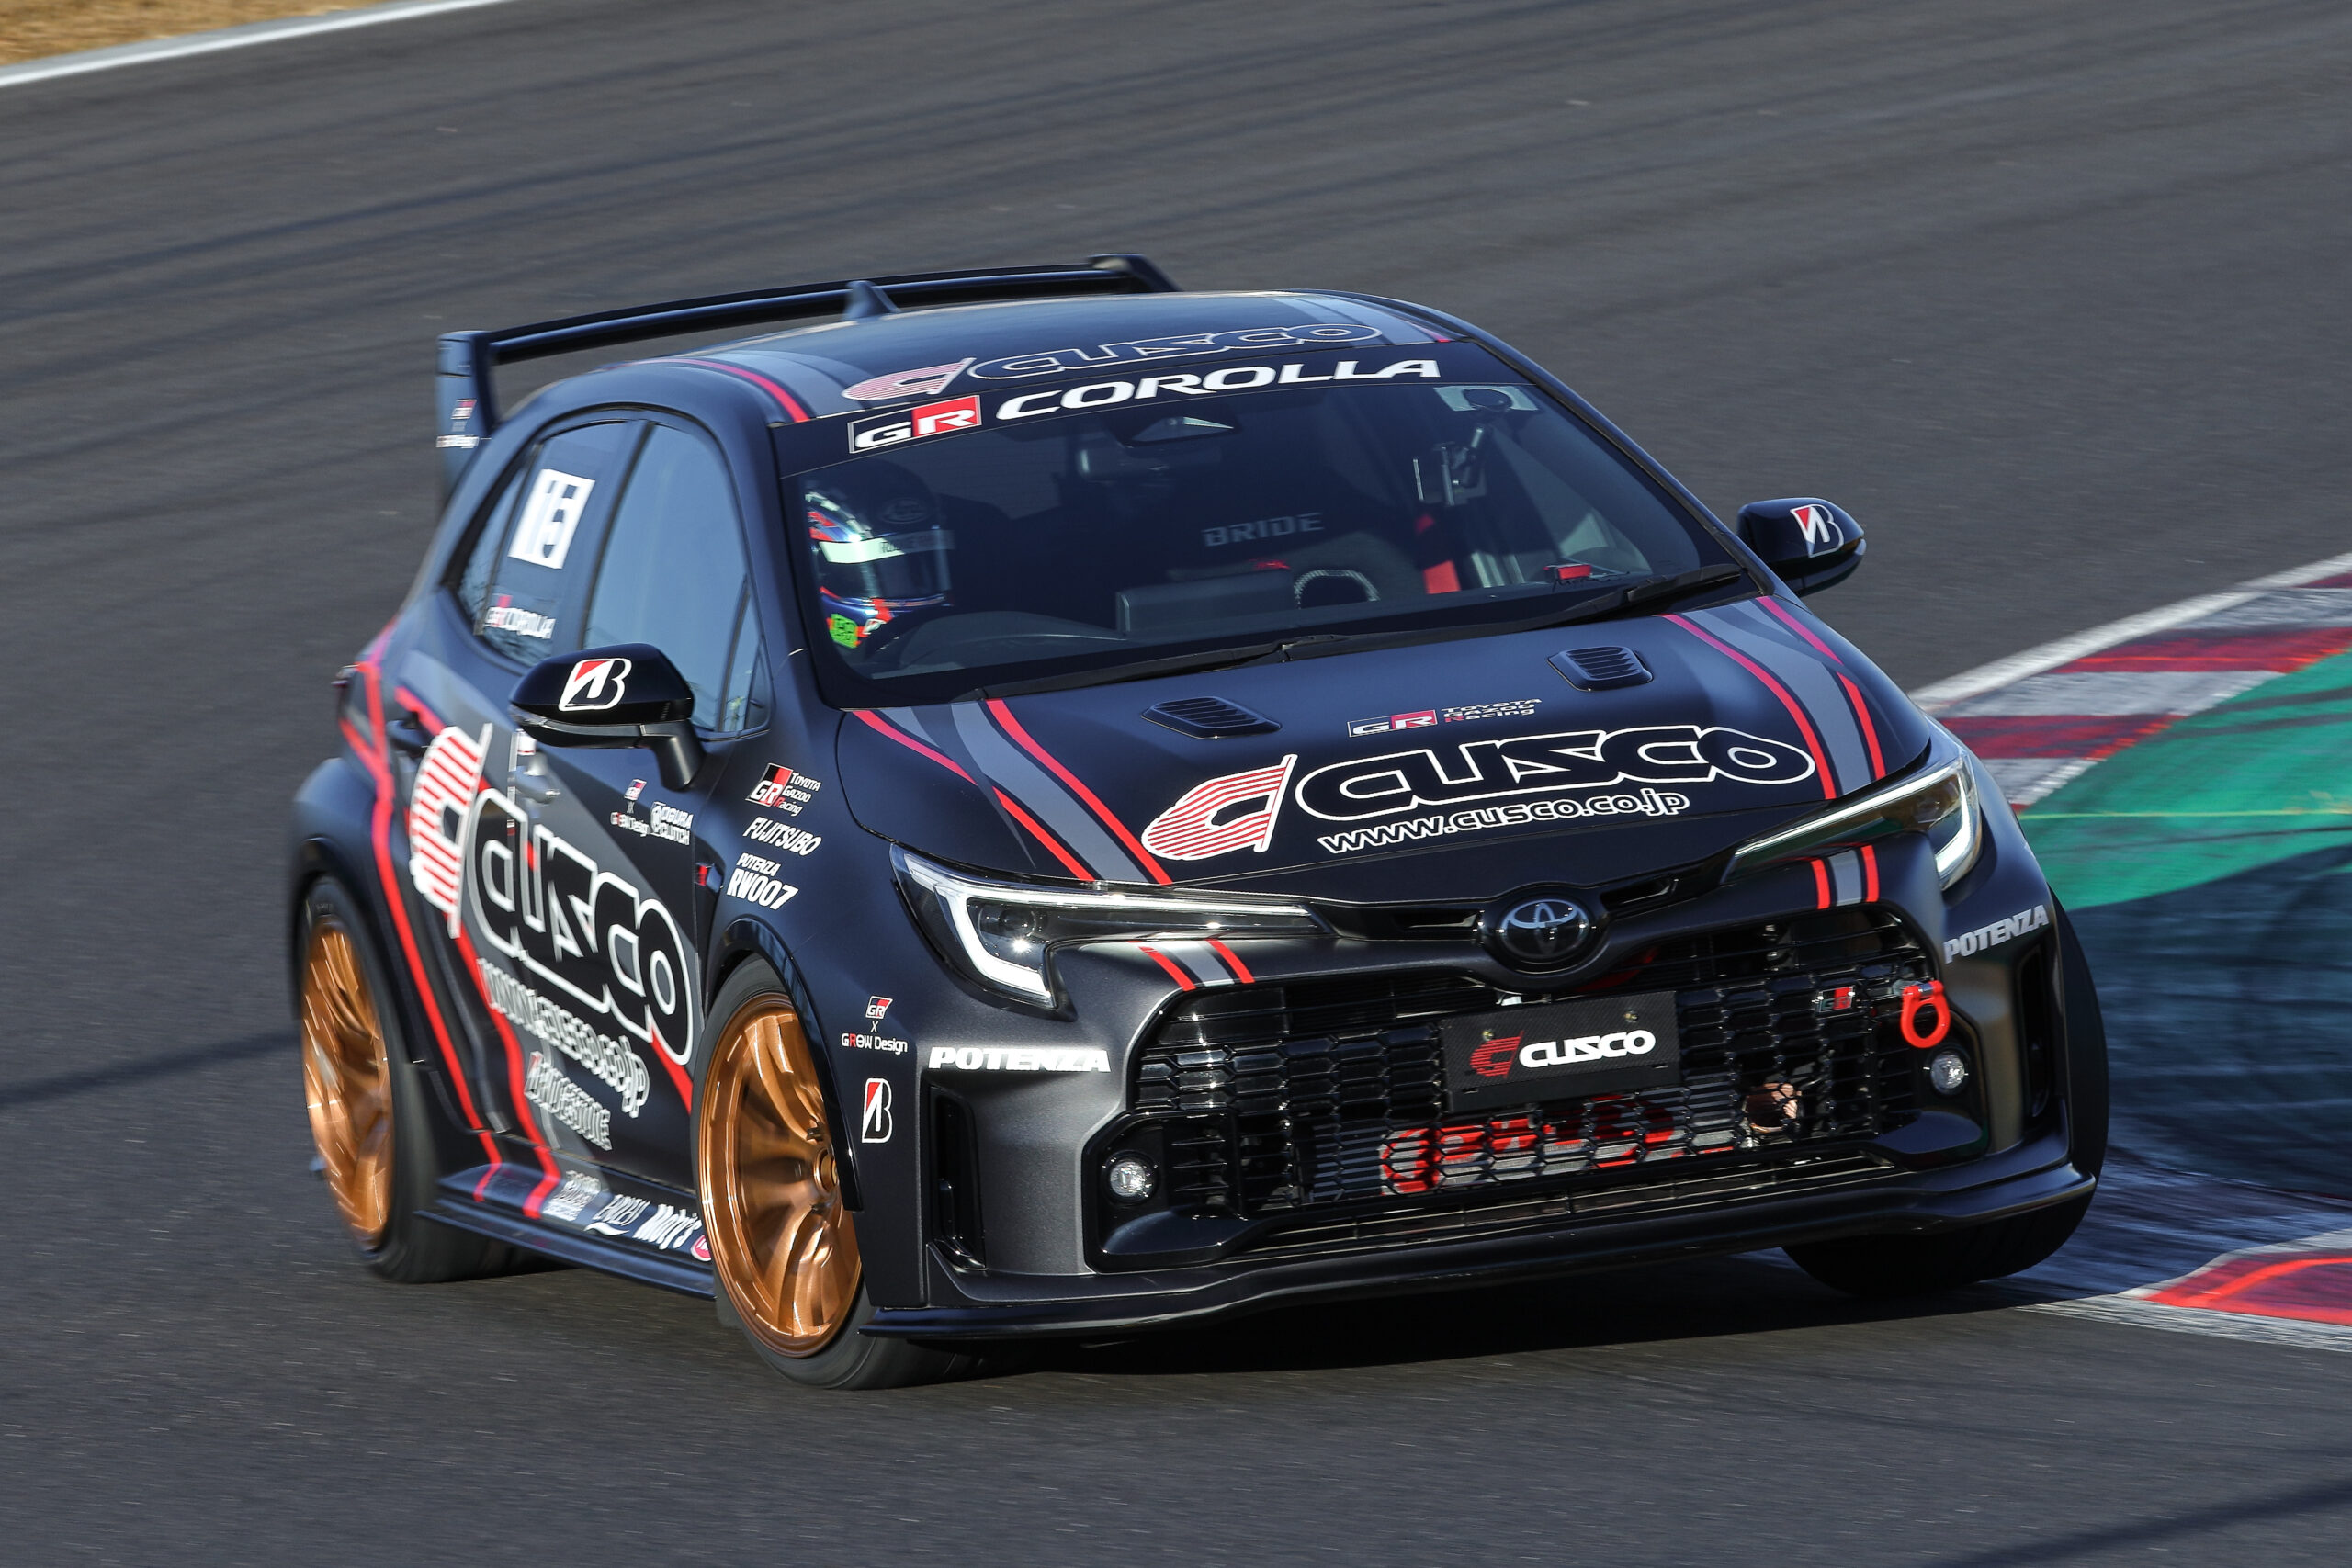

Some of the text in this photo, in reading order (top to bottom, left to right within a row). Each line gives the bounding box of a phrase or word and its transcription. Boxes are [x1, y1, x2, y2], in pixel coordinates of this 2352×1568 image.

[854, 358, 1442, 451] GR COROLLA
[1201, 512, 1326, 547] BRIDE
[1441, 698, 1543, 713] TOYOTA
[1444, 708, 1535, 723] Racing
[1351, 715, 1434, 735] GR
[750, 779, 784, 805] GR
[782, 785, 812, 804] GAZOO
[789, 772, 821, 792] TOYOTA
[774, 796, 804, 817] Racing
[1317, 788, 1690, 854] www.cusco.co.jp
[742, 816, 822, 856] FUJITSUBO
[736, 852, 781, 876] POTENZA
[726, 868, 799, 910] RW007
[1943, 904, 2050, 964] POTENZA
[874, 1036, 909, 1055] Design
[928, 1046, 1111, 1073] POTENZA
